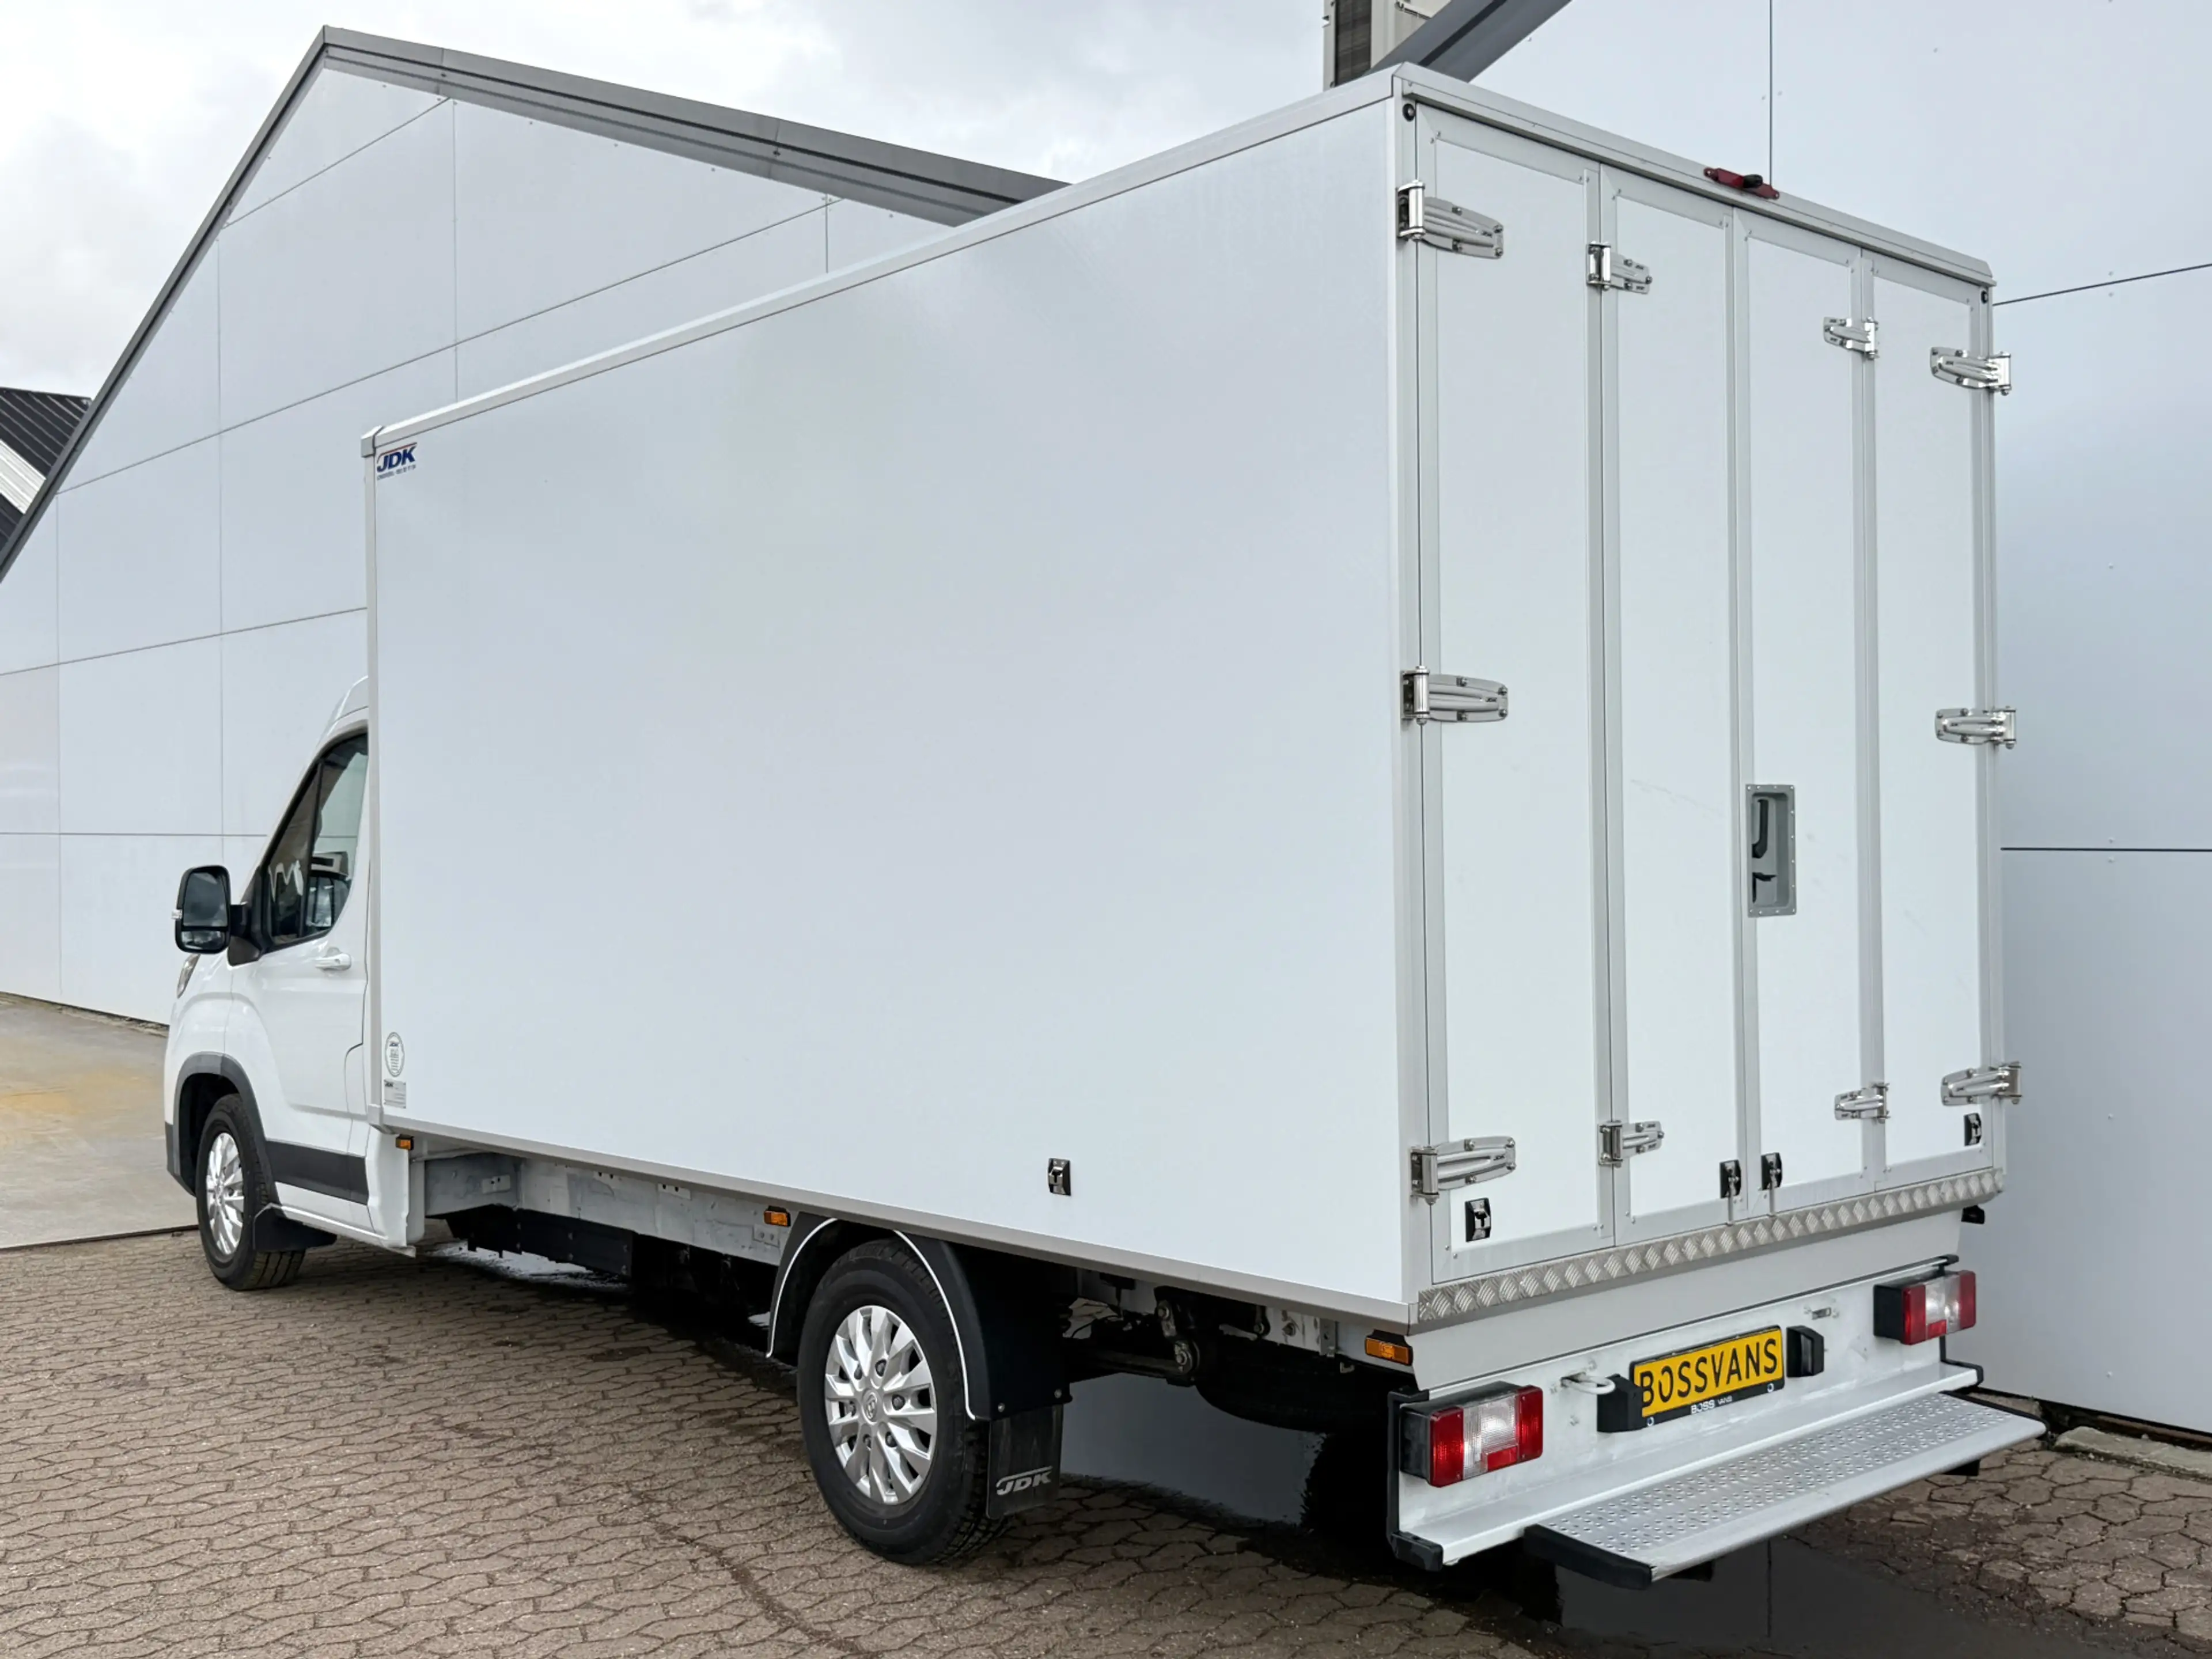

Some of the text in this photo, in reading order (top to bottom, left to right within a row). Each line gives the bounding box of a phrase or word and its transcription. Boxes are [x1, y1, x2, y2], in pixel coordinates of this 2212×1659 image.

[377, 446, 416, 472] JDK
[1640, 1338, 1777, 1407] BOSSVANS
[1691, 1399, 1715, 1414] BOSS
[997, 1471, 1051, 1495] JDK
